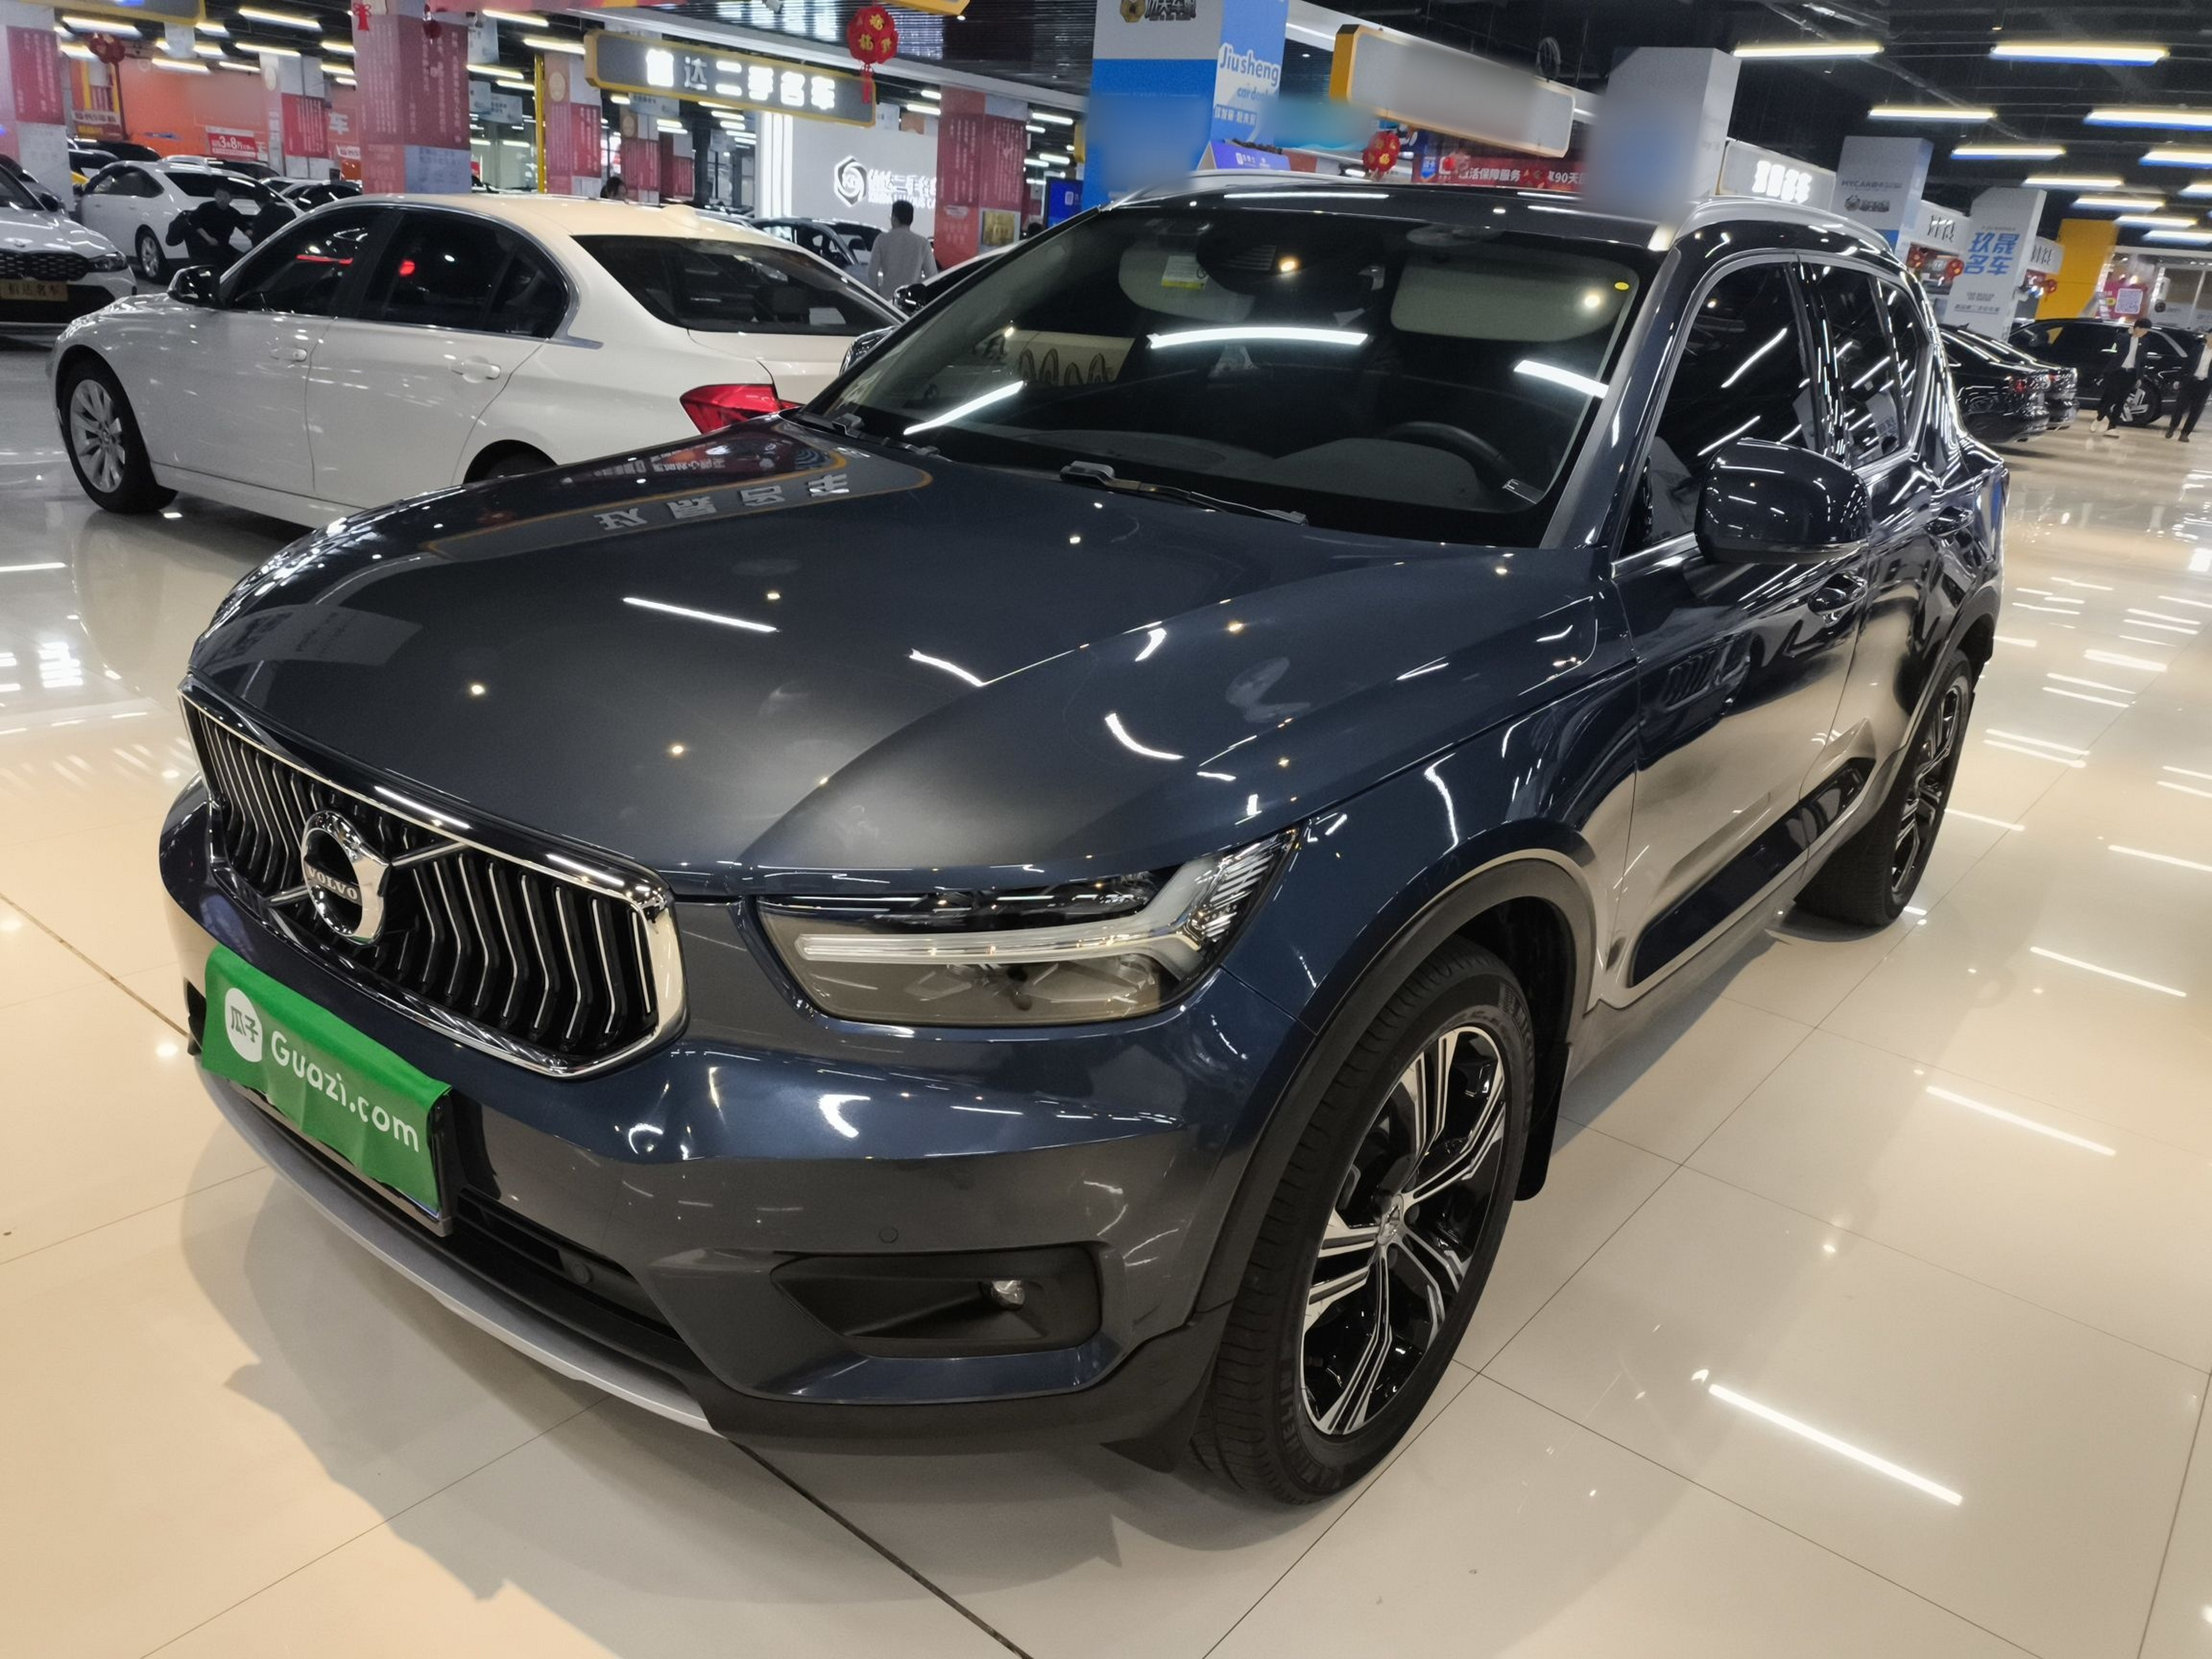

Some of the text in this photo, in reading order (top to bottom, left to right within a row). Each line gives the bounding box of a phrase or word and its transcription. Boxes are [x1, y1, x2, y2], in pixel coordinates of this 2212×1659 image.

[646, 48, 835, 111] 达二手名车
[1219, 46, 1279, 87] Jiusheng
[1968, 232, 2020, 254] 玖晟
[1963, 254, 2014, 275] 名车
[306, 864, 358, 900] VOLVO
[230, 1005, 259, 1044] 瓜子
[271, 1031, 419, 1153] Guazi.com
